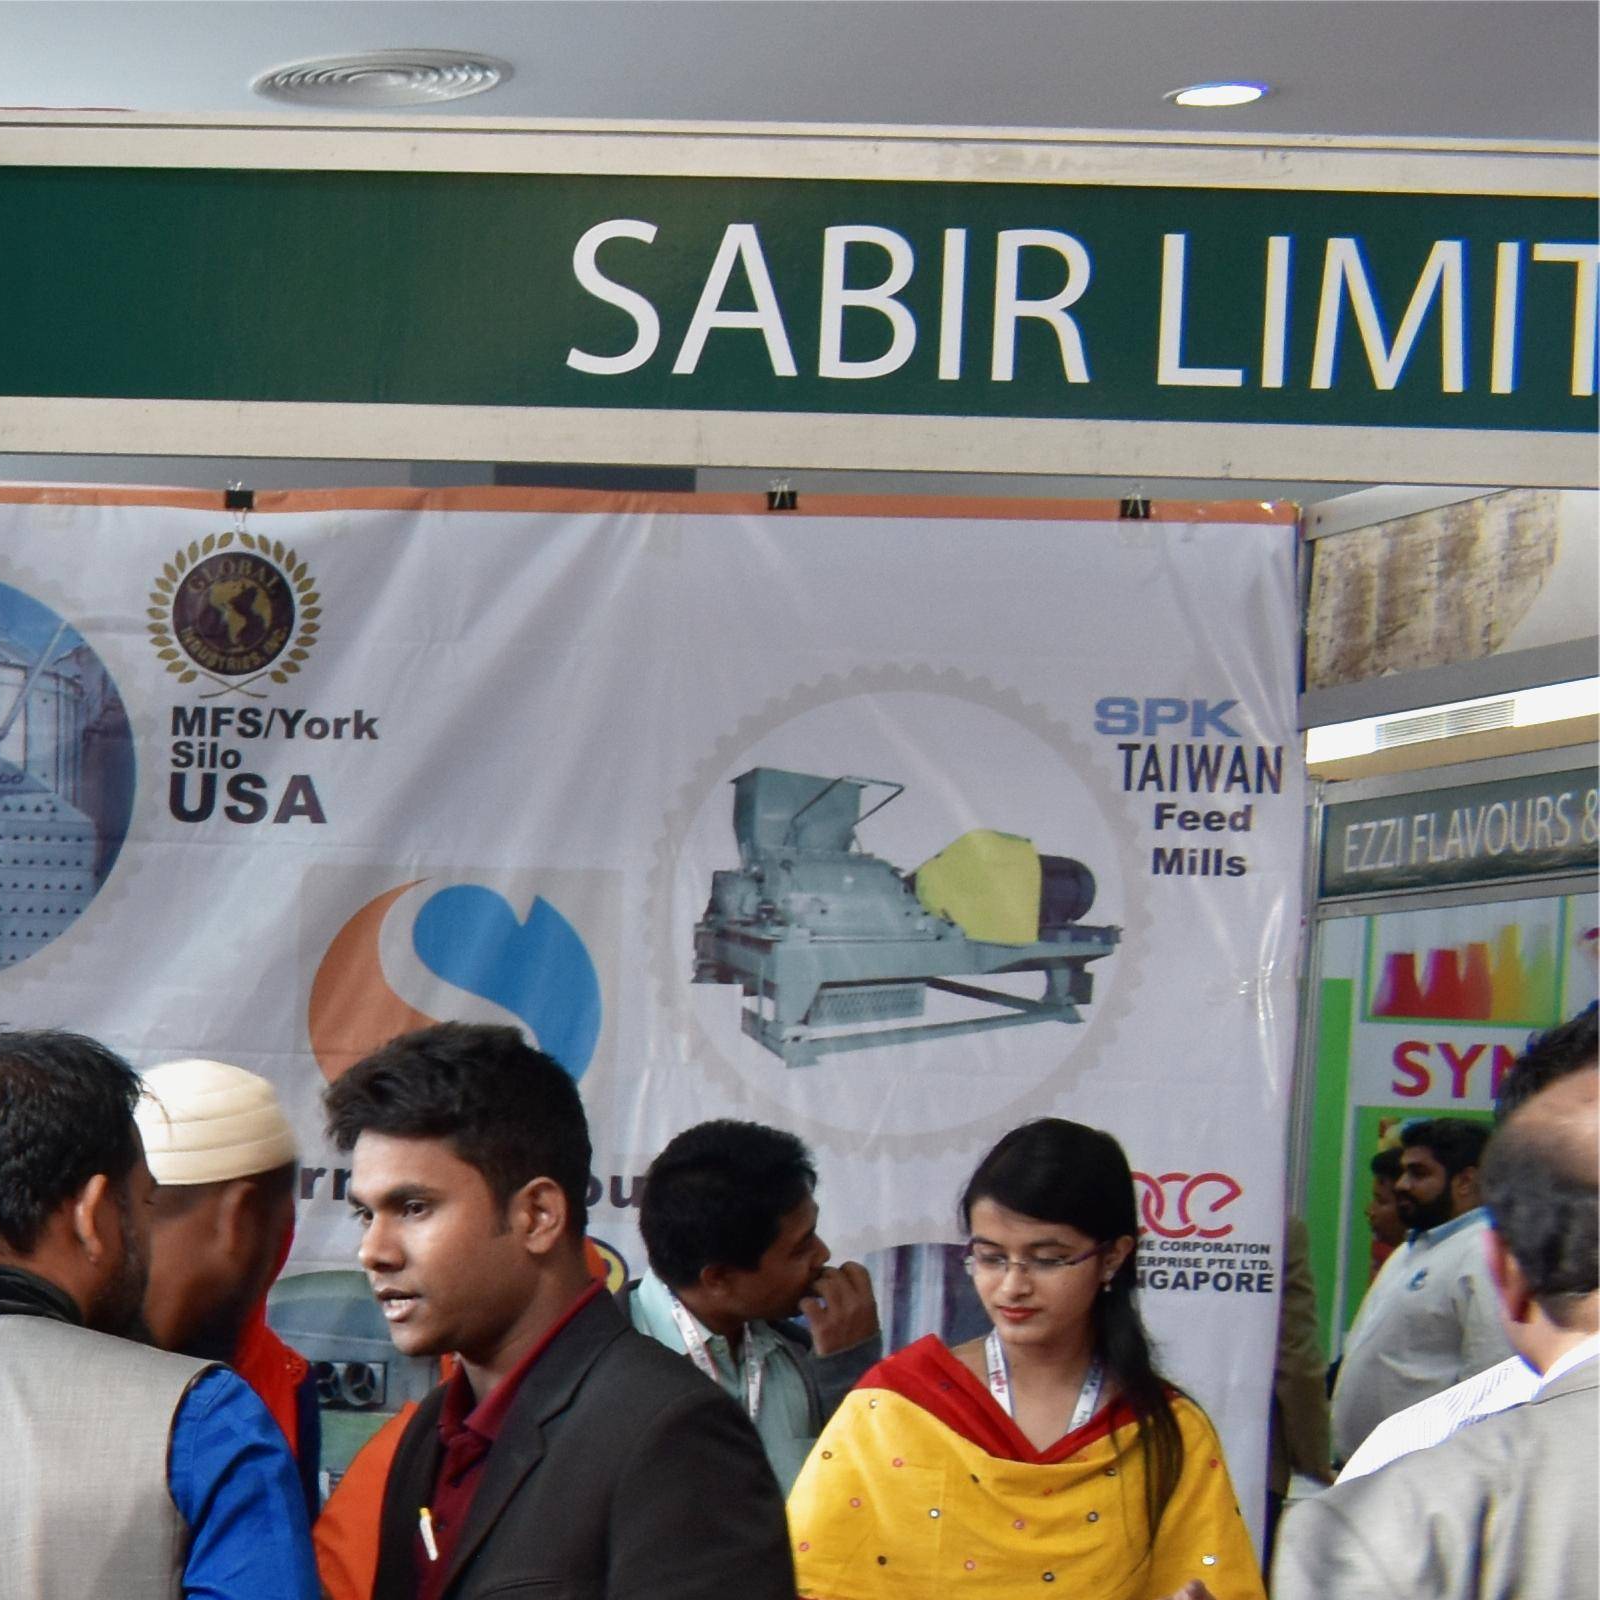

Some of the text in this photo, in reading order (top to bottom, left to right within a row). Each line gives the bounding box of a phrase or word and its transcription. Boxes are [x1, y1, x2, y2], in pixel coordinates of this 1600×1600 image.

[566, 217, 1599, 397] SABIR LIMIT
[170, 705, 380, 741] MFS/York
[1093, 696, 1243, 738] SPK
[170, 741, 243, 770] Silo
[1117, 743, 1284, 795] TAIWAN
[168, 771, 328, 825] USA
[1154, 802, 1254, 832] Feed
[1343, 817, 1403, 873] EZZI
[1409, 791, 1573, 866] FLAVOURS
[1152, 846, 1247, 877] Mills
[1159, 1240, 1271, 1255] CORPORATION
[1207, 1258, 1236, 1270] PTE
[1241, 1259, 1275, 1271] LTD.
